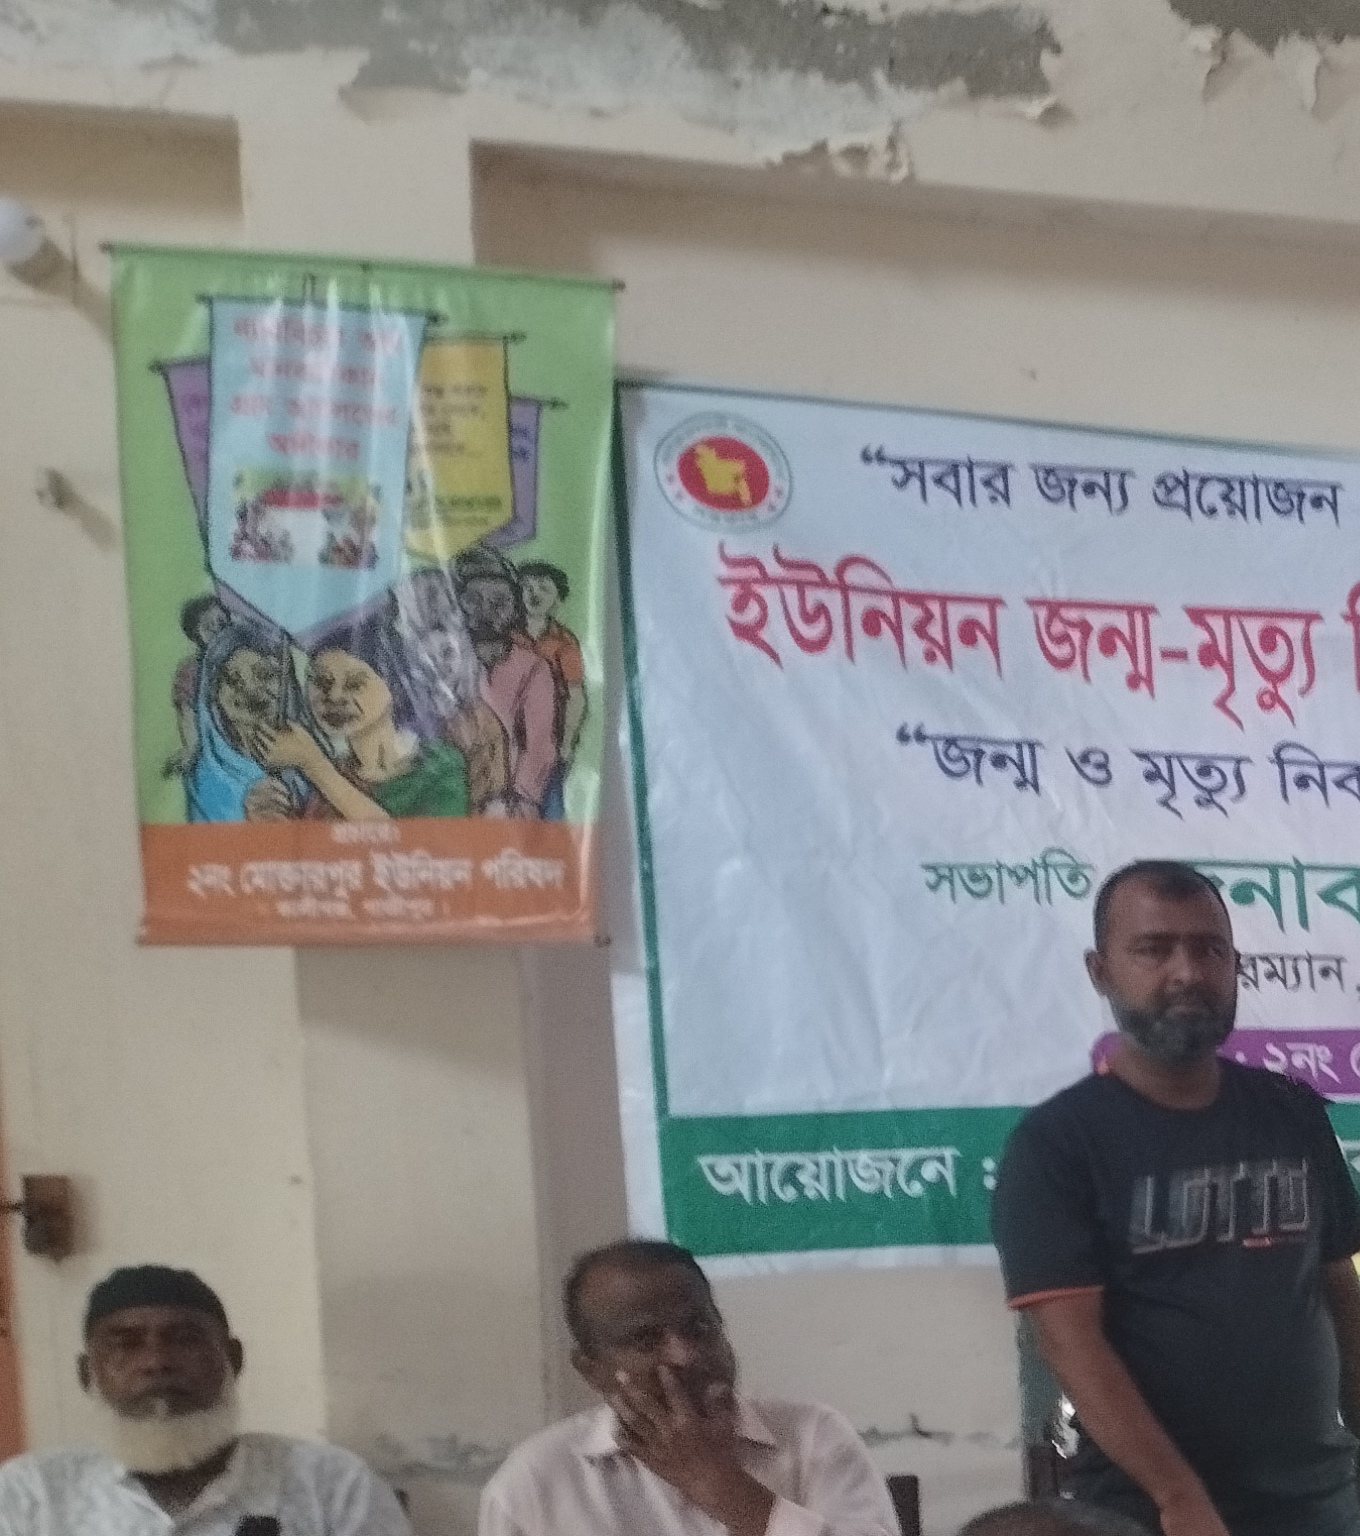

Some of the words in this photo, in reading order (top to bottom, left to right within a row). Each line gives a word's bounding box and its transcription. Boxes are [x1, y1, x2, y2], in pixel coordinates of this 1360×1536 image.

[861, 444, 1013, 508] “সবার
[1030, 465, 1134, 515] জন্য
[1153, 470, 1342, 528] প্রয়োজন
[718, 541, 1006, 680] ইউনিয়ন
[895, 724, 1044, 795] “জন্ম
[1065, 746, 1115, 789] ও
[1133, 748, 1254, 818] মৃত্যু
[920, 847, 1095, 907] সভাপতি
